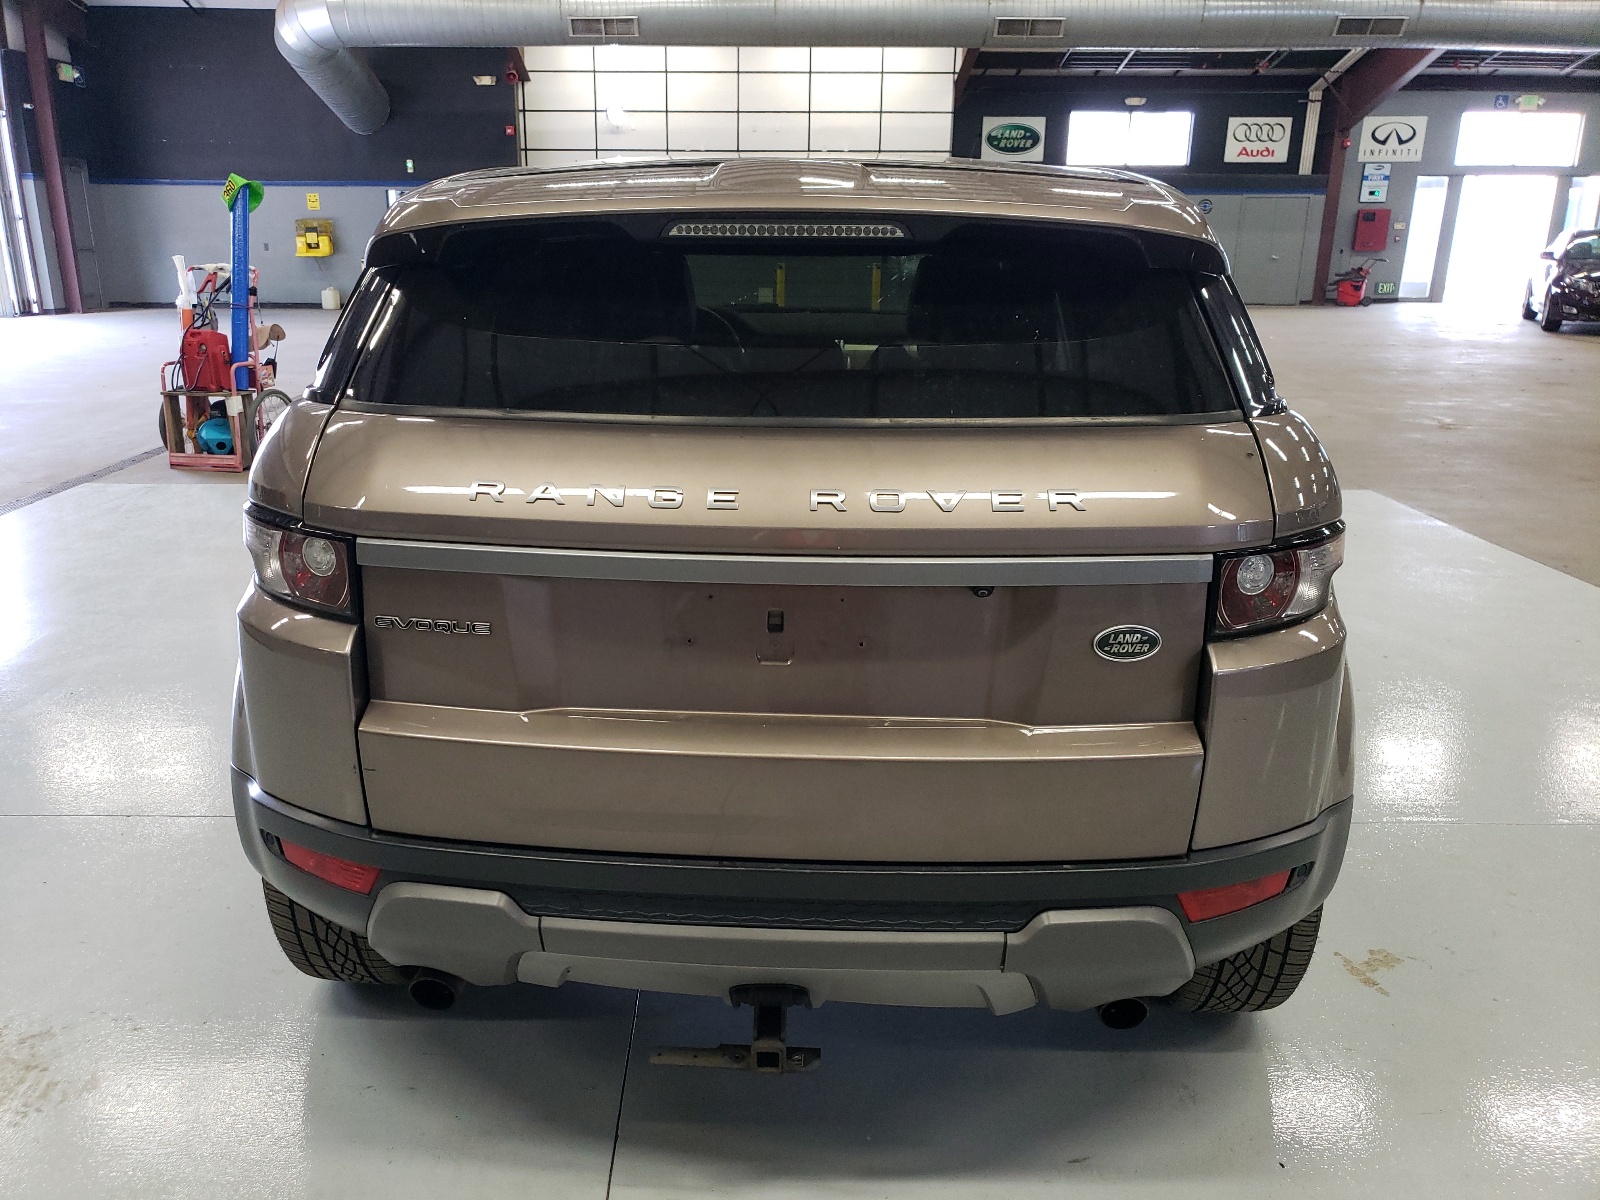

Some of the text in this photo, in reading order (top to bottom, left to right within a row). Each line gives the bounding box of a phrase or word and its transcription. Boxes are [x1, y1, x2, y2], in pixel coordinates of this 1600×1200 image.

[997, 129, 1025, 139] LAND
[999, 139, 1033, 148] ROVER
[1236, 146, 1275, 157] Audi
[1363, 148, 1419, 157] INFINITI
[1378, 282, 1394, 293] EXIT
[468, 479, 1087, 512] RANGE ROVER
[374, 615, 491, 635] EVOQUE
[1109, 634, 1141, 643] LAND
[1110, 644, 1150, 653] ROVER
